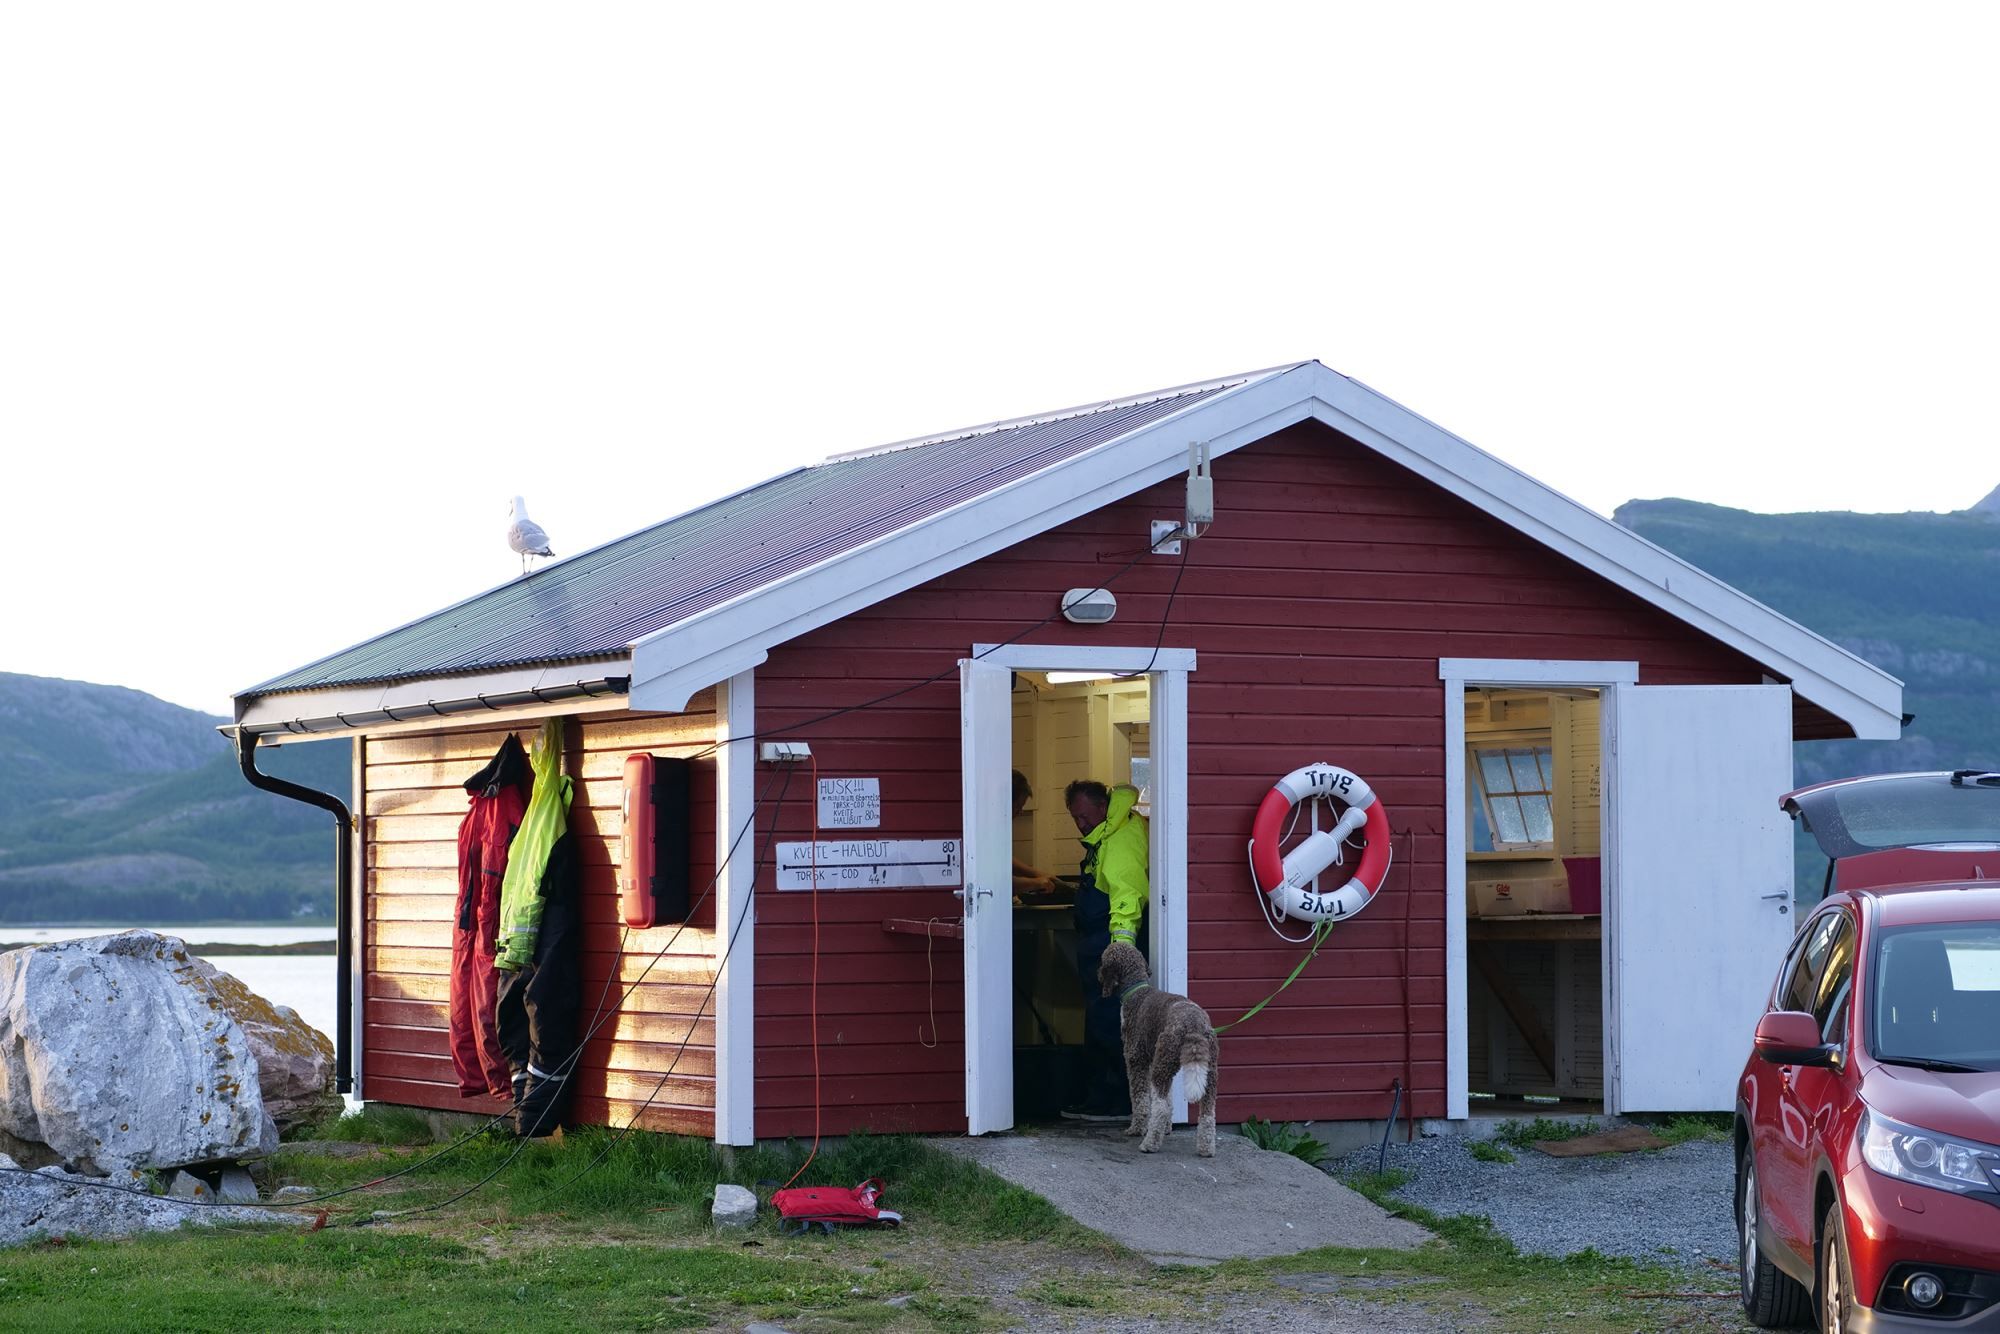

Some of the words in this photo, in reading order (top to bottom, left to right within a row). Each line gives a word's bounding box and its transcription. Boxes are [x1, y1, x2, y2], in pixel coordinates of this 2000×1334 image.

[820, 779, 864, 795] HUSK!!!
[1304, 770, 1354, 795] Tryg
[833, 808, 853, 816] KVEITE
[833, 816, 863, 825] HALIBUT
[793, 845, 829, 860] KVETE
[942, 841, 955, 853] 80
[841, 868, 859, 879] COD
[941, 869, 953, 877] cm
[1298, 892, 1347, 917] Tryg
